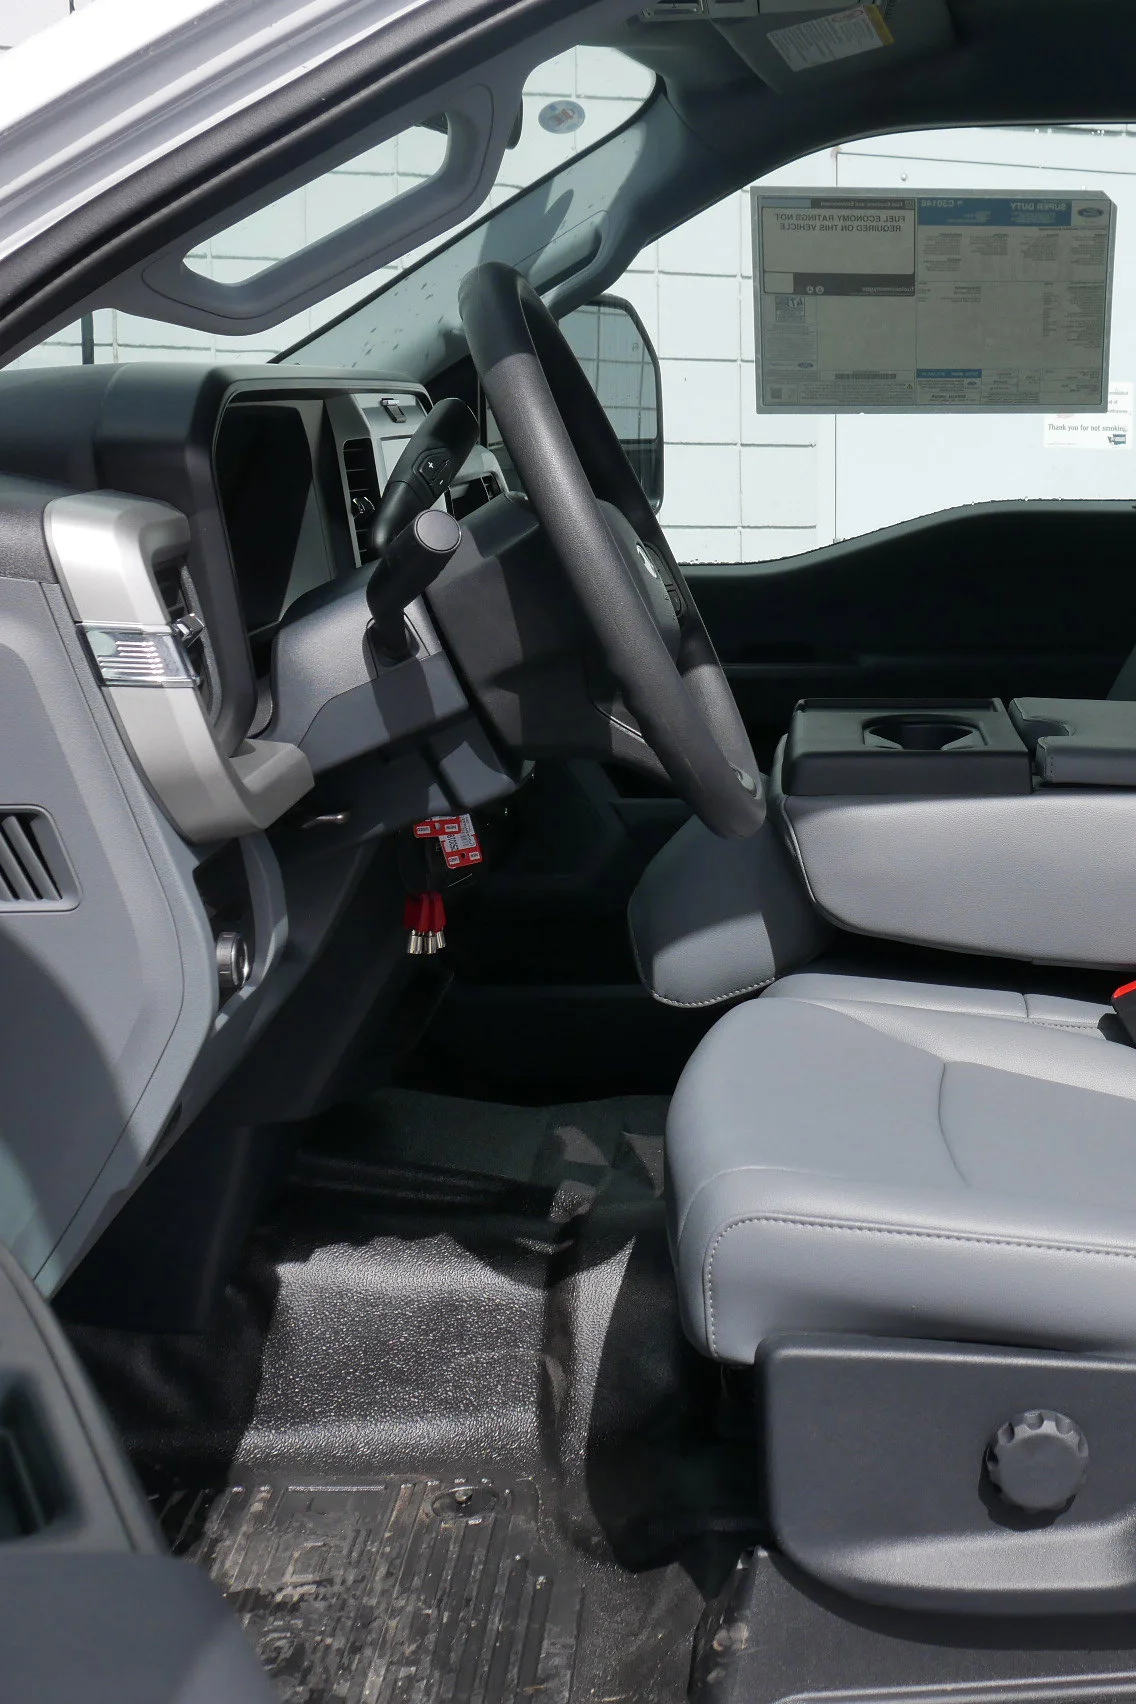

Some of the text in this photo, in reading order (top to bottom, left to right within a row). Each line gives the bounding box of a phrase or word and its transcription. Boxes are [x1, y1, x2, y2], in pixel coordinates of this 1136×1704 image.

[1047, 423, 1067, 431] Thank
[1067, 425, 1079, 433] you
[1080, 423, 1089, 432] for
[1090, 424, 1101, 432] not
